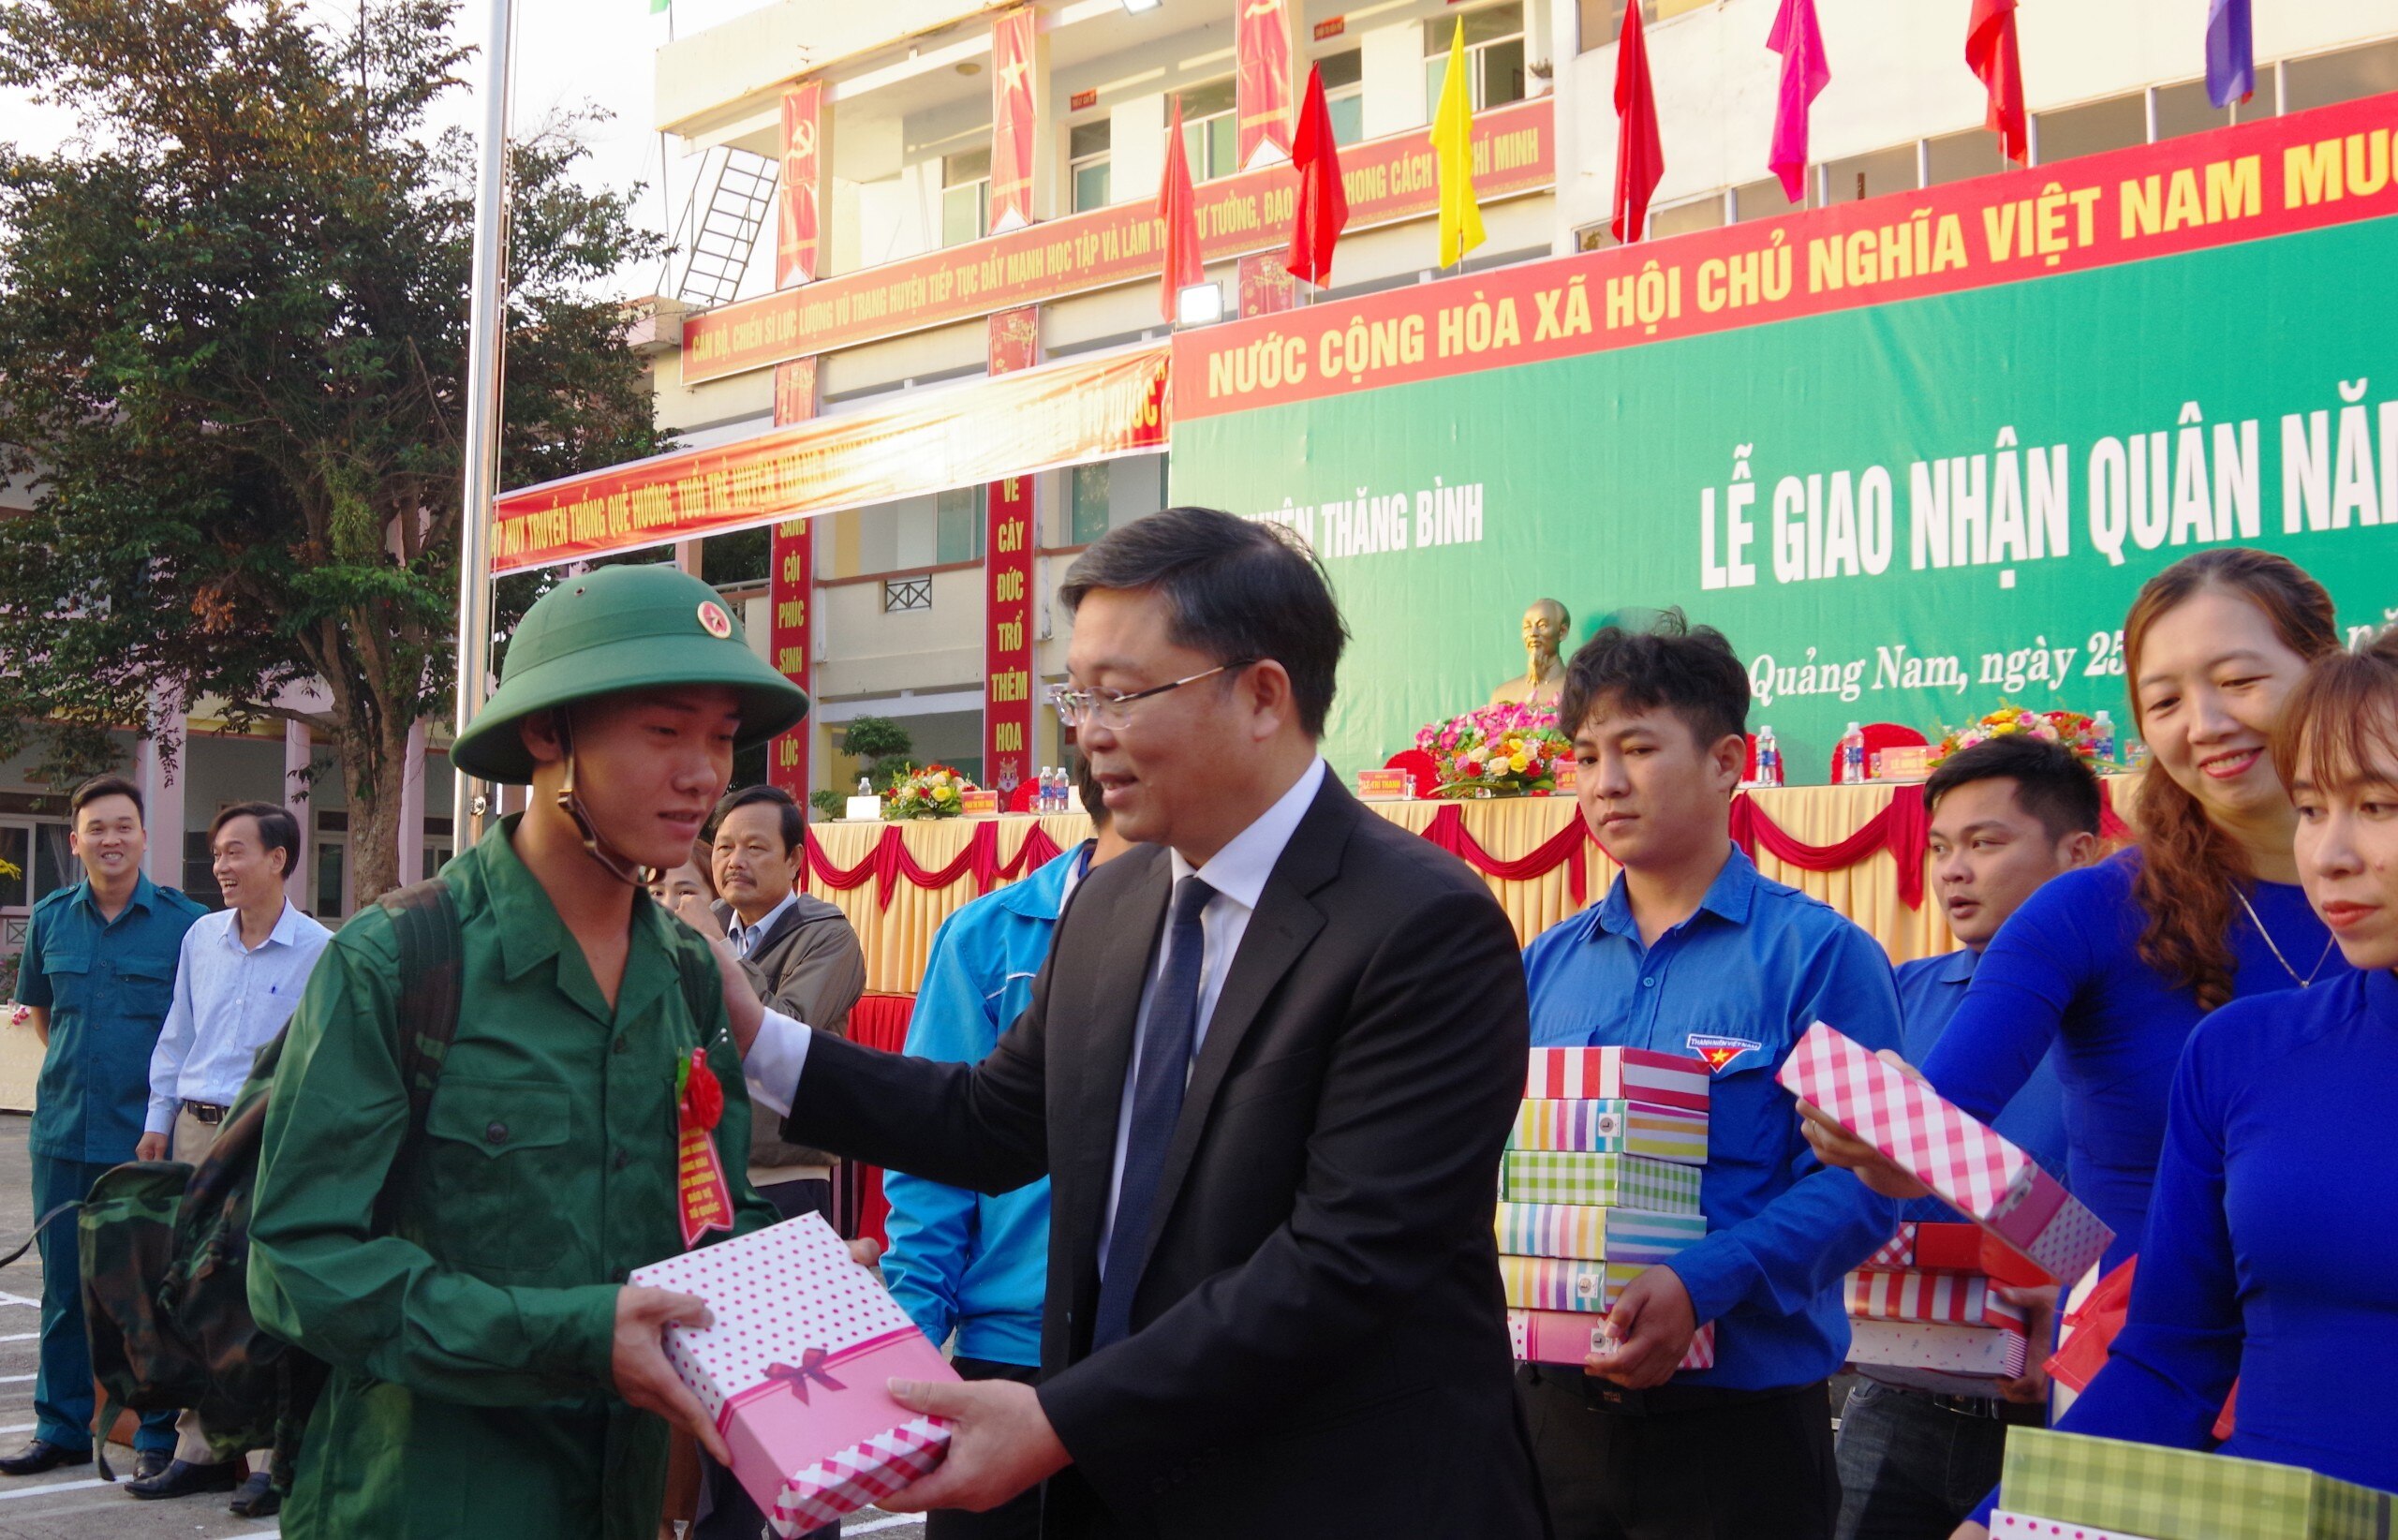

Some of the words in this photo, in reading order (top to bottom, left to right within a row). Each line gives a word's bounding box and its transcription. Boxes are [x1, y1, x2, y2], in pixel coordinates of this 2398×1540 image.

[692, 329, 714, 363] CÁN
[715, 322, 731, 362] BỘ,
[733, 312, 762, 353] CHIẾN
[765, 310, 777, 346] SĨ
[777, 307, 797, 348] LỰC
[799, 299, 834, 339] LƯỢNG
[836, 291, 851, 328] VŨ
[851, 287, 887, 323] TRANG
[890, 273, 926, 315] HUYỆN
[929, 262, 954, 304] TIẾP
[956, 264, 978, 303] TỤC
[981, 246, 1004, 291] ĐẨY
[1007, 246, 1044, 289] MẠNH
[1046, 239, 1072, 279] HỌC
[1074, 230, 1098, 274] TẬP
[1103, 222, 1119, 262] VÀ
[1122, 217, 1150, 258] LÀM
[1211, 189, 1261, 236] TƯỞNG,
[1265, 186, 1294, 230] ĐẠO
[1343, 163, 1386, 206] HONG
[1390, 150, 1432, 195] CÁCH
[1471, 131, 1489, 179] HÍ
[1494, 126, 1539, 171] MINH
[1208, 333, 1307, 398] NƯỚC
[1319, 316, 1425, 383] CỘNG
[1438, 290, 1521, 358] HÒA
[1533, 276, 1593, 342] XÃ
[1606, 260, 1681, 336] HỘI
[1696, 229, 1793, 313] CHỦ
[1808, 208, 1968, 294] NGHĨA
[1982, 183, 2102, 266] VIỆT
[2119, 155, 2261, 240] NAM
[2283, 127, 2398, 211] MU
[505, 514, 525, 556] HUY
[526, 496, 568, 553] TRUYỀN
[570, 486, 606, 543] THỐNG
[608, 484, 630, 539] QUÊ
[631, 481, 676, 529] HƯƠNG,
[676, 458, 705, 521] TUỔI
[706, 454, 731, 513] TRẺ
[1699, 442, 1756, 591] LỄ
[1771, 465, 1892, 585] GIAO
[1910, 425, 2068, 590] NHẬN
[2088, 400, 2260, 568] QUÂN
[998, 516, 1025, 554] CÂY
[1321, 486, 1408, 560] THĂNG
[1415, 476, 1484, 550] BÌNH
[783, 550, 801, 588] CỘI
[997, 566, 1024, 602] ĐỨC
[778, 596, 805, 629] PHÚC
[997, 609, 1024, 652] TRỔ
[779, 645, 803, 674] SINH
[1749, 646, 1866, 707] Quảng
[1871, 644, 1968, 695] Nam,
[1978, 635, 2077, 693] ngày
[991, 666, 1028, 703] THÊM
[779, 735, 799, 772] LỘC
[996, 722, 1022, 752] HOA
